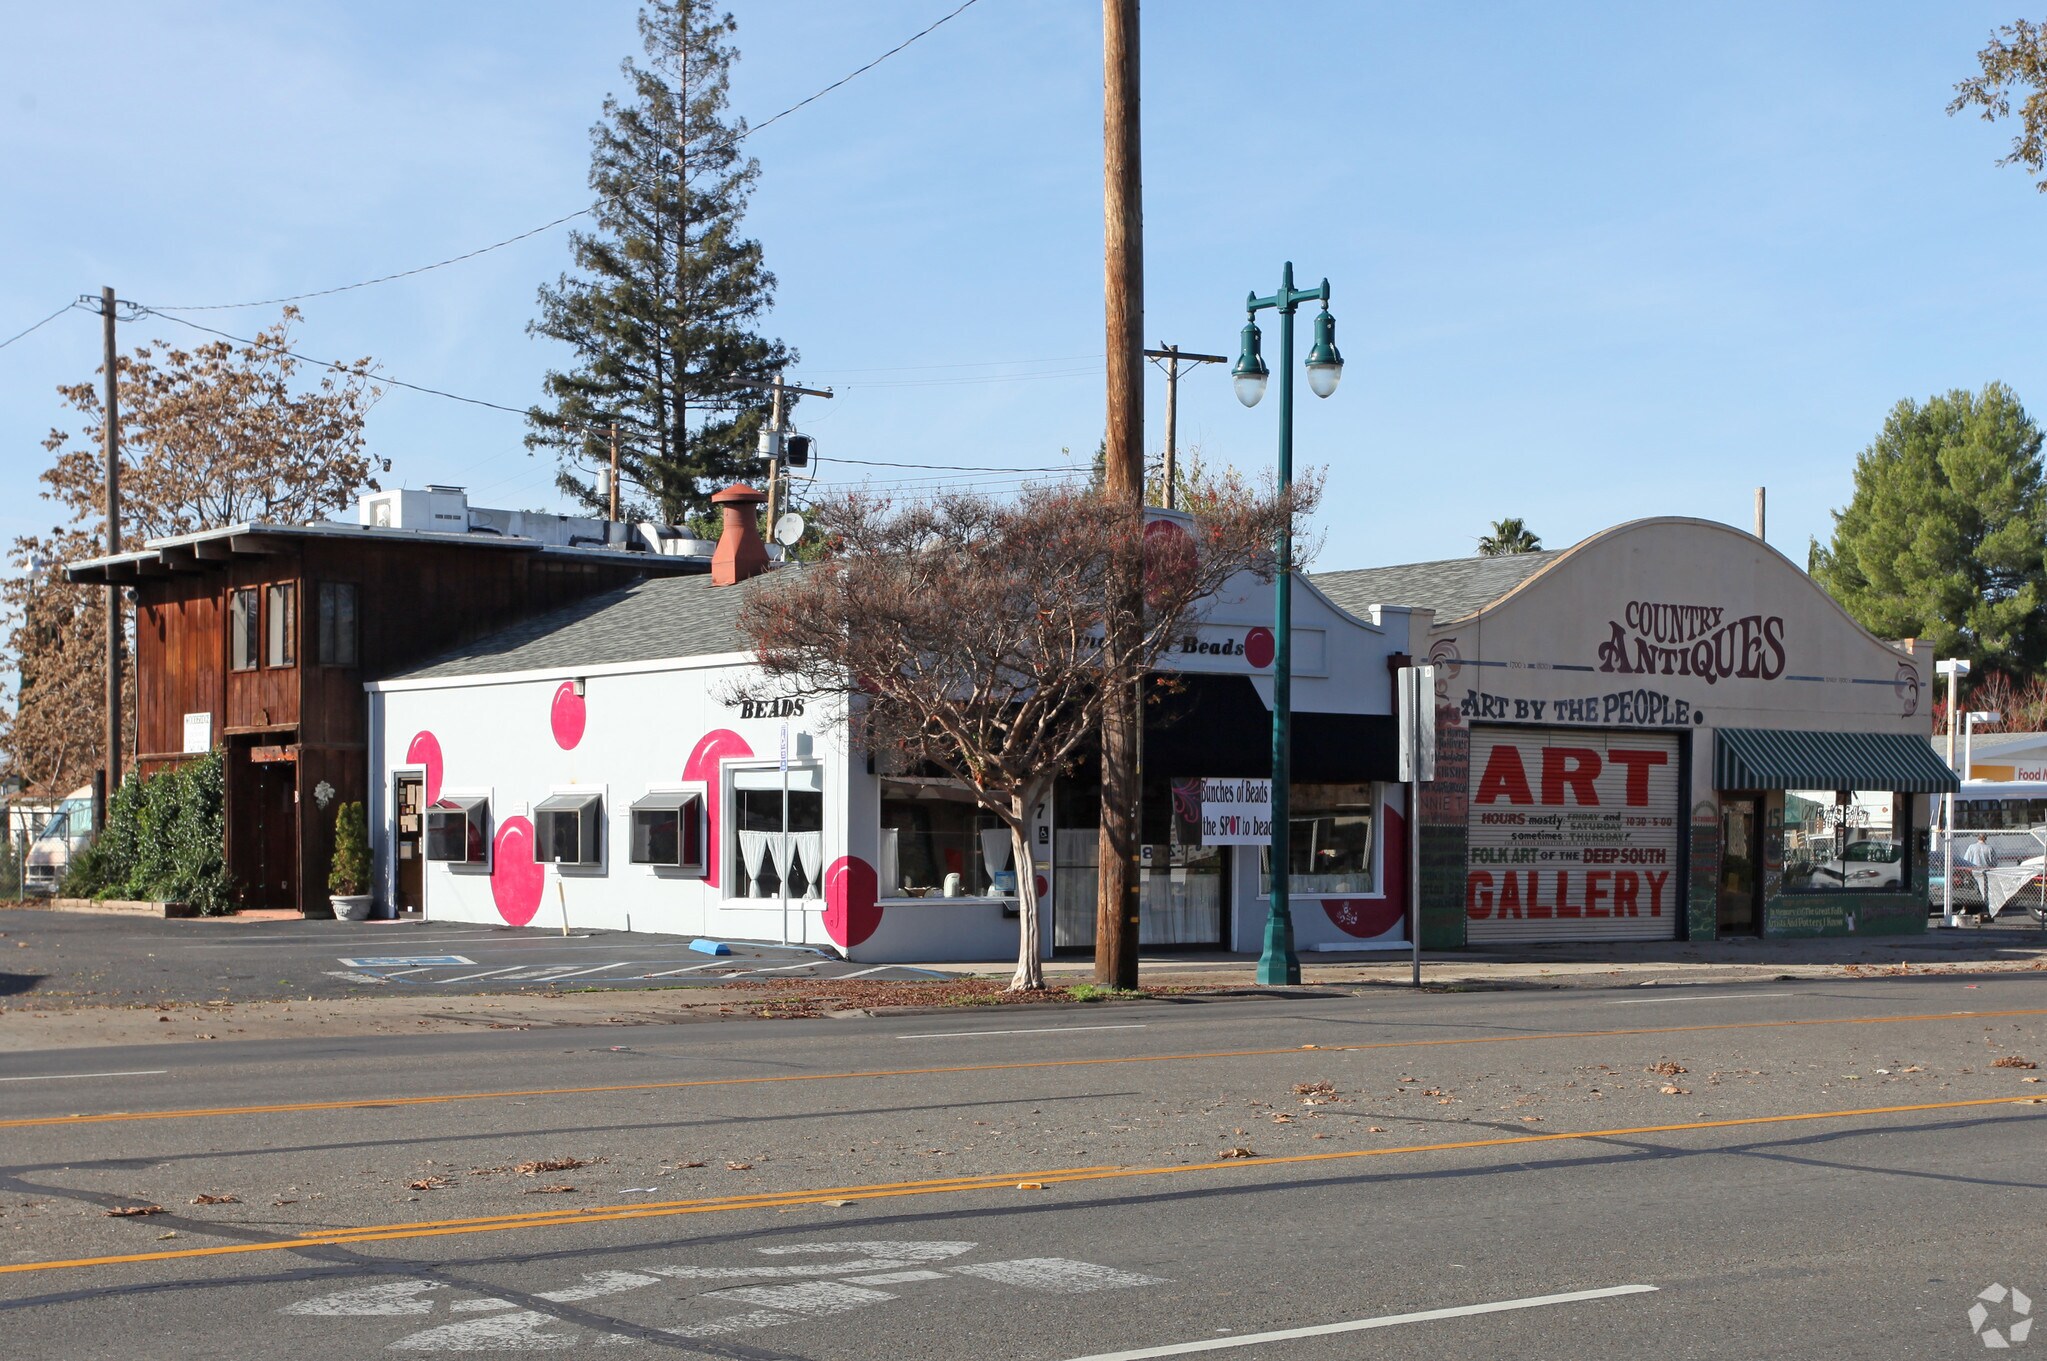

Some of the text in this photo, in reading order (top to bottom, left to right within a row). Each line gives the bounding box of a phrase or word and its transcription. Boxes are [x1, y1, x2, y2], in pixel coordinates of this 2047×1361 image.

[1625, 600, 1724, 644] COUNTRY
[1180, 635, 1245, 656] Beads
[1598, 615, 1786, 685] ANTIQUES
[740, 698, 805, 719] BEADS
[1461, 689, 1509, 719] ART
[1514, 699, 1547, 720] BY
[1554, 697, 1599, 723] THE
[1474, 745, 1668, 807] ART
[2018, 766, 2041, 780] Food
[1201, 778, 1268, 803] Bunches of Beads
[1203, 816, 1217, 836] the
[1242, 816, 1250, 836] to
[1481, 813, 1525, 825] HOURS
[1567, 813, 1600, 821] FRIDAY
[1603, 812, 1621, 822] and
[1570, 822, 1623, 831] SATURDAY
[1471, 847, 1509, 864] FOLK
[1511, 847, 1539, 864] ART
[1540, 852, 1555, 861] OF
[1559, 852, 1580, 861] THE
[1583, 848, 1620, 864] DEEP
[1620, 848, 1666, 864] SOUTH
[1467, 870, 1670, 920] GALLERY
